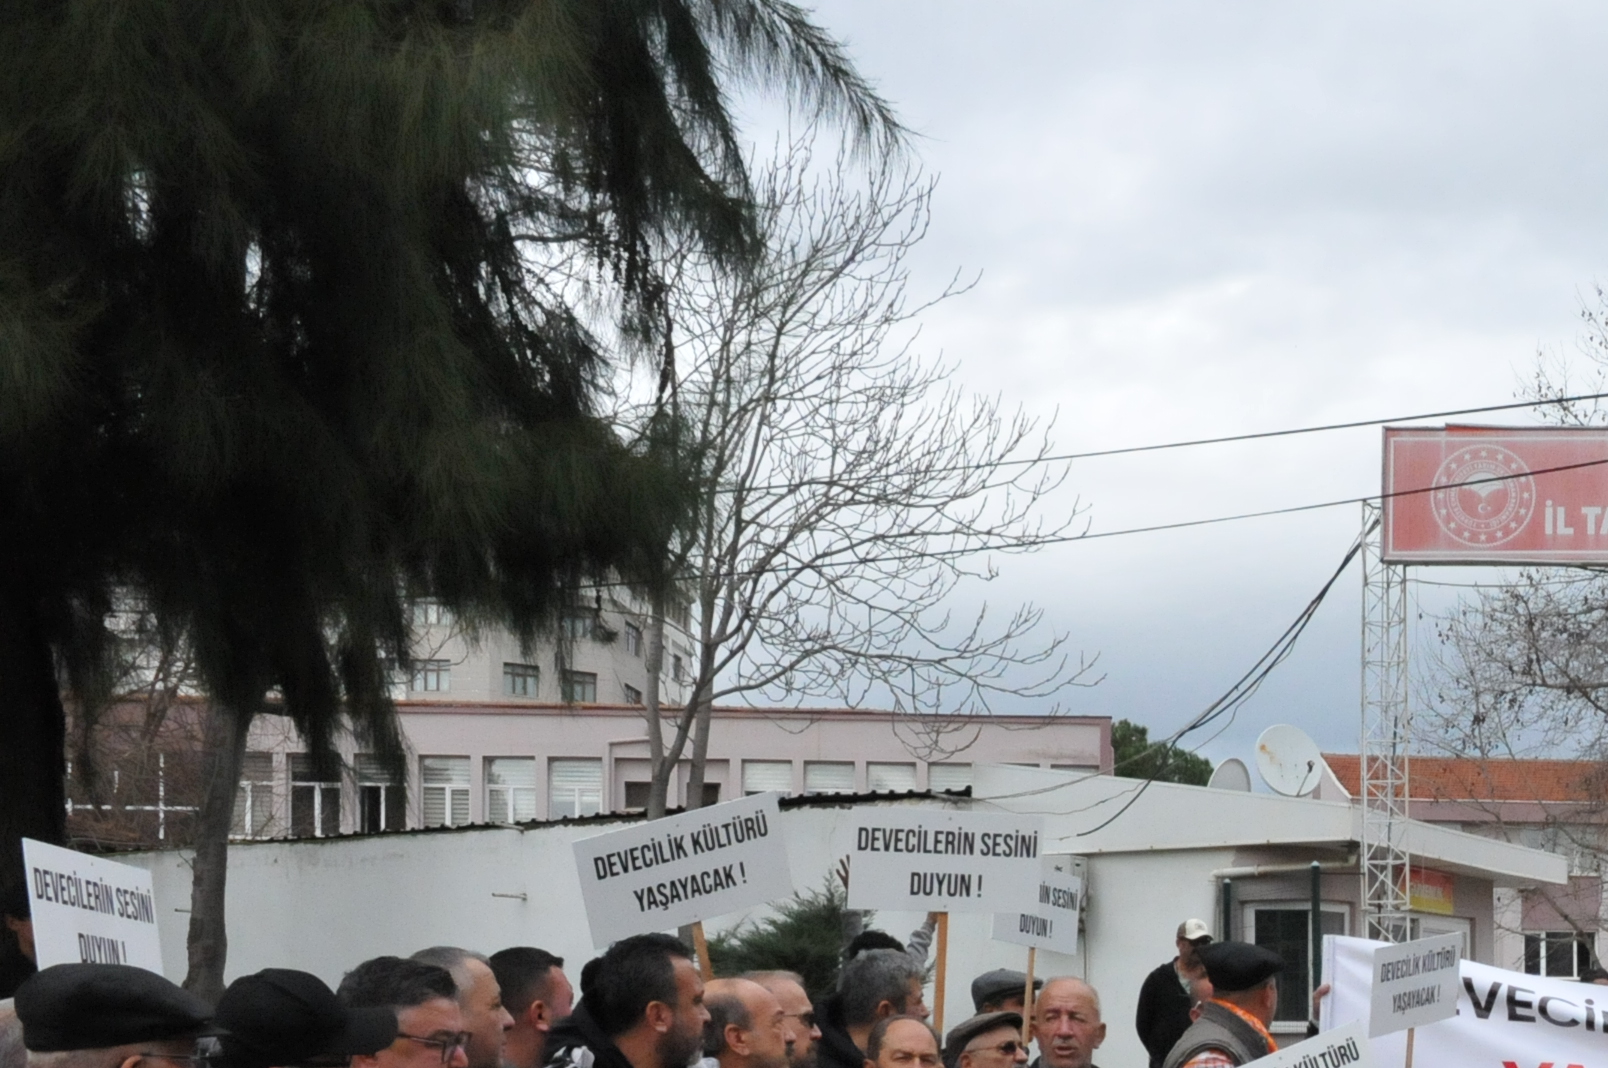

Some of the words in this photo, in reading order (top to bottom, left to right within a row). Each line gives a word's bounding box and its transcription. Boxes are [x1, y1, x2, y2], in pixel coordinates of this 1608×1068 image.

[1544, 500, 1575, 536] İL
[594, 834, 689, 880] DEVECİLİK
[693, 810, 769, 856] KÜLTÜRÜ
[857, 826, 976, 857] DEVECİLERİN
[980, 828, 1038, 858] SESİNİ
[33, 866, 115, 916] DEVECİLERİN
[115, 885, 154, 924] SESİNİ
[633, 867, 738, 913] YAŞAYACAK
[739, 862, 748, 884] !
[909, 871, 972, 898] DUYUN
[977, 874, 983, 898] !
[1051, 886, 1078, 911] SESİNİ
[1019, 913, 1048, 938] DUYUN
[1381, 953, 1421, 983] DEVECİLİK
[1421, 945, 1456, 974] KÜLTÜRÜ
[1392, 985, 1436, 1015] YAŞAYACAK
